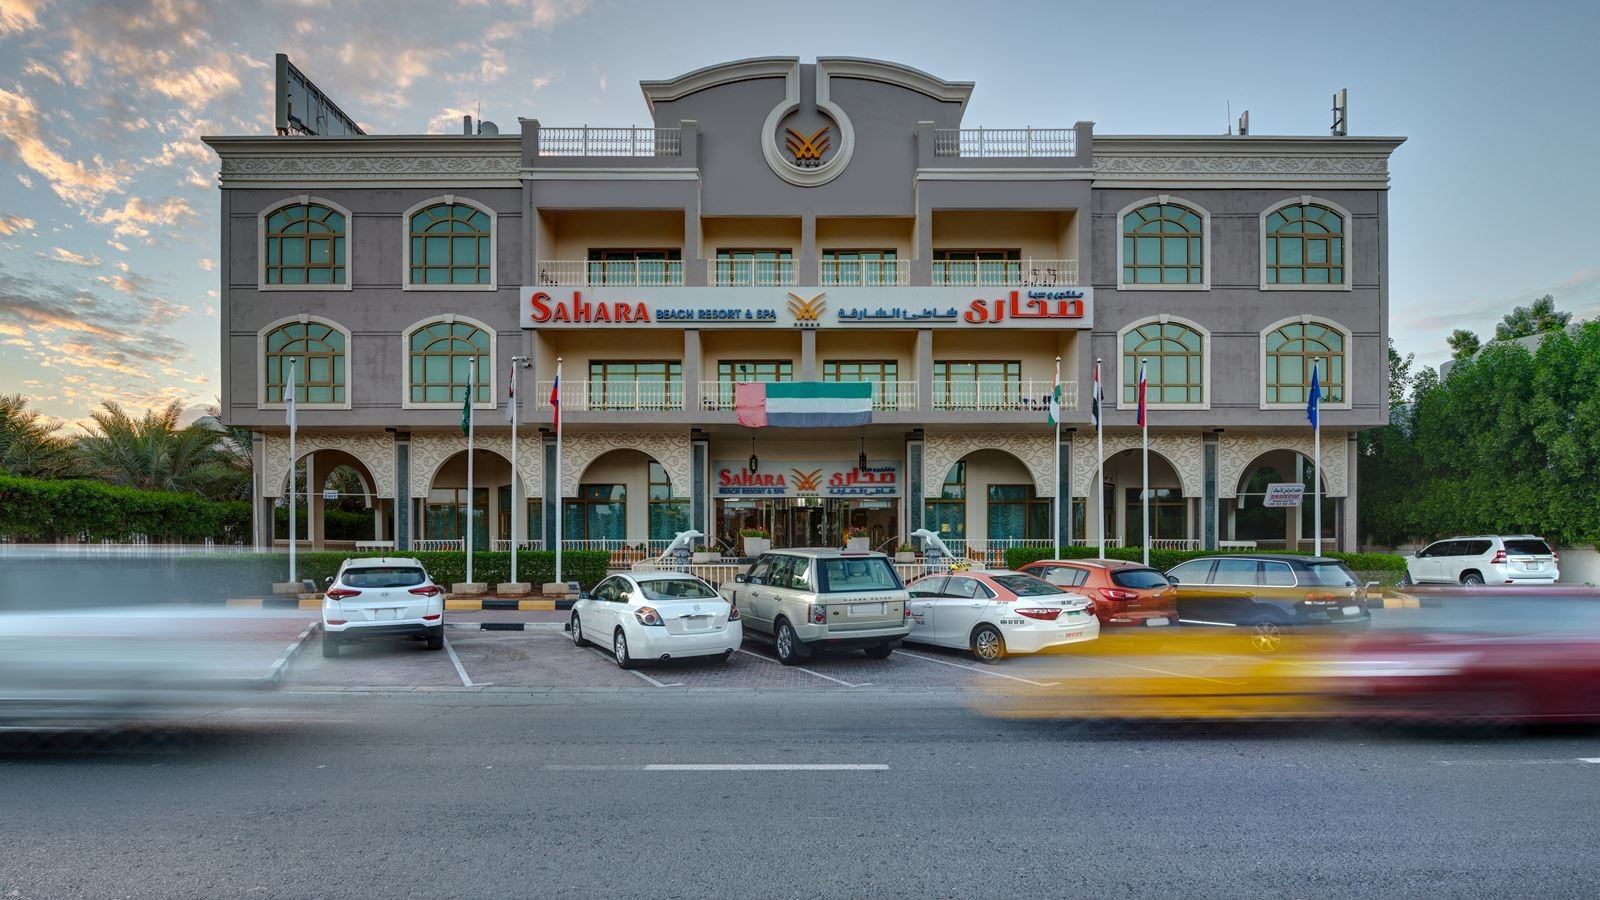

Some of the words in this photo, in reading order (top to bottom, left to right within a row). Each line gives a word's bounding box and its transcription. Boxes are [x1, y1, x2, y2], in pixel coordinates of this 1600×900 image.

[531, 291, 650, 323] SAHARA
[655, 309, 694, 319] BEACH
[698, 309, 741, 319] RESORT
[745, 309, 753, 319] &
[756, 309, 777, 319] SPA
[838, 307, 900, 320] الشارقة
[903, 307, 958, 320] شاطئ
[719, 467, 786, 487] SAHARA
